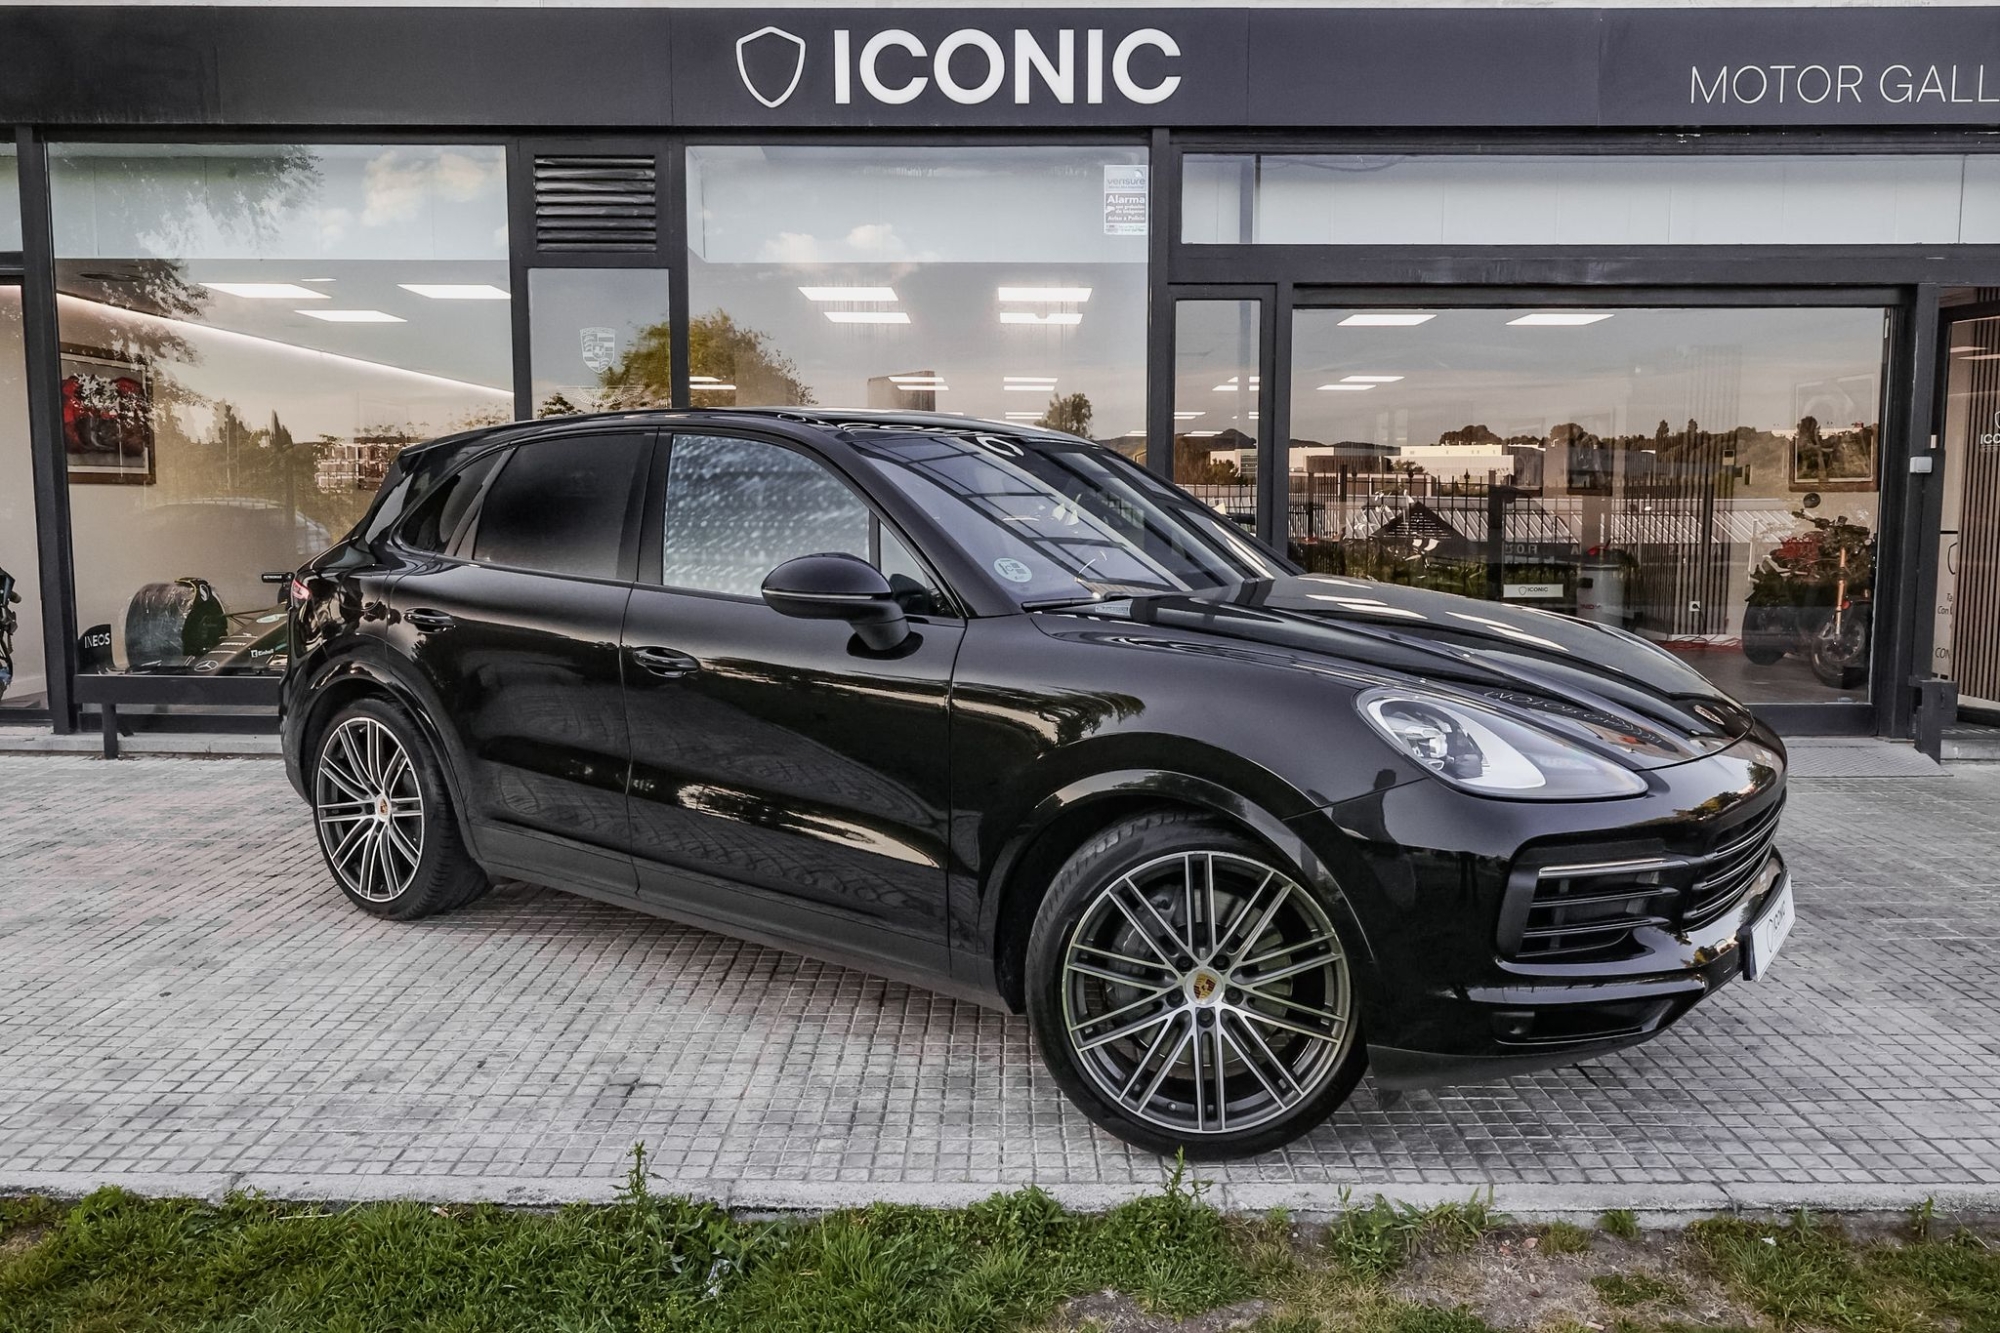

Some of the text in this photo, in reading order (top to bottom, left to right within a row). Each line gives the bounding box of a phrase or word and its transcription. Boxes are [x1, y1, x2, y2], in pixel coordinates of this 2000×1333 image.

[834, 28, 1182, 104] ICONIC
[1690, 64, 2000, 103] MOTOR GALL
[1107, 194, 1145, 204] Alarma
[84, 632, 111, 649] INEOS
